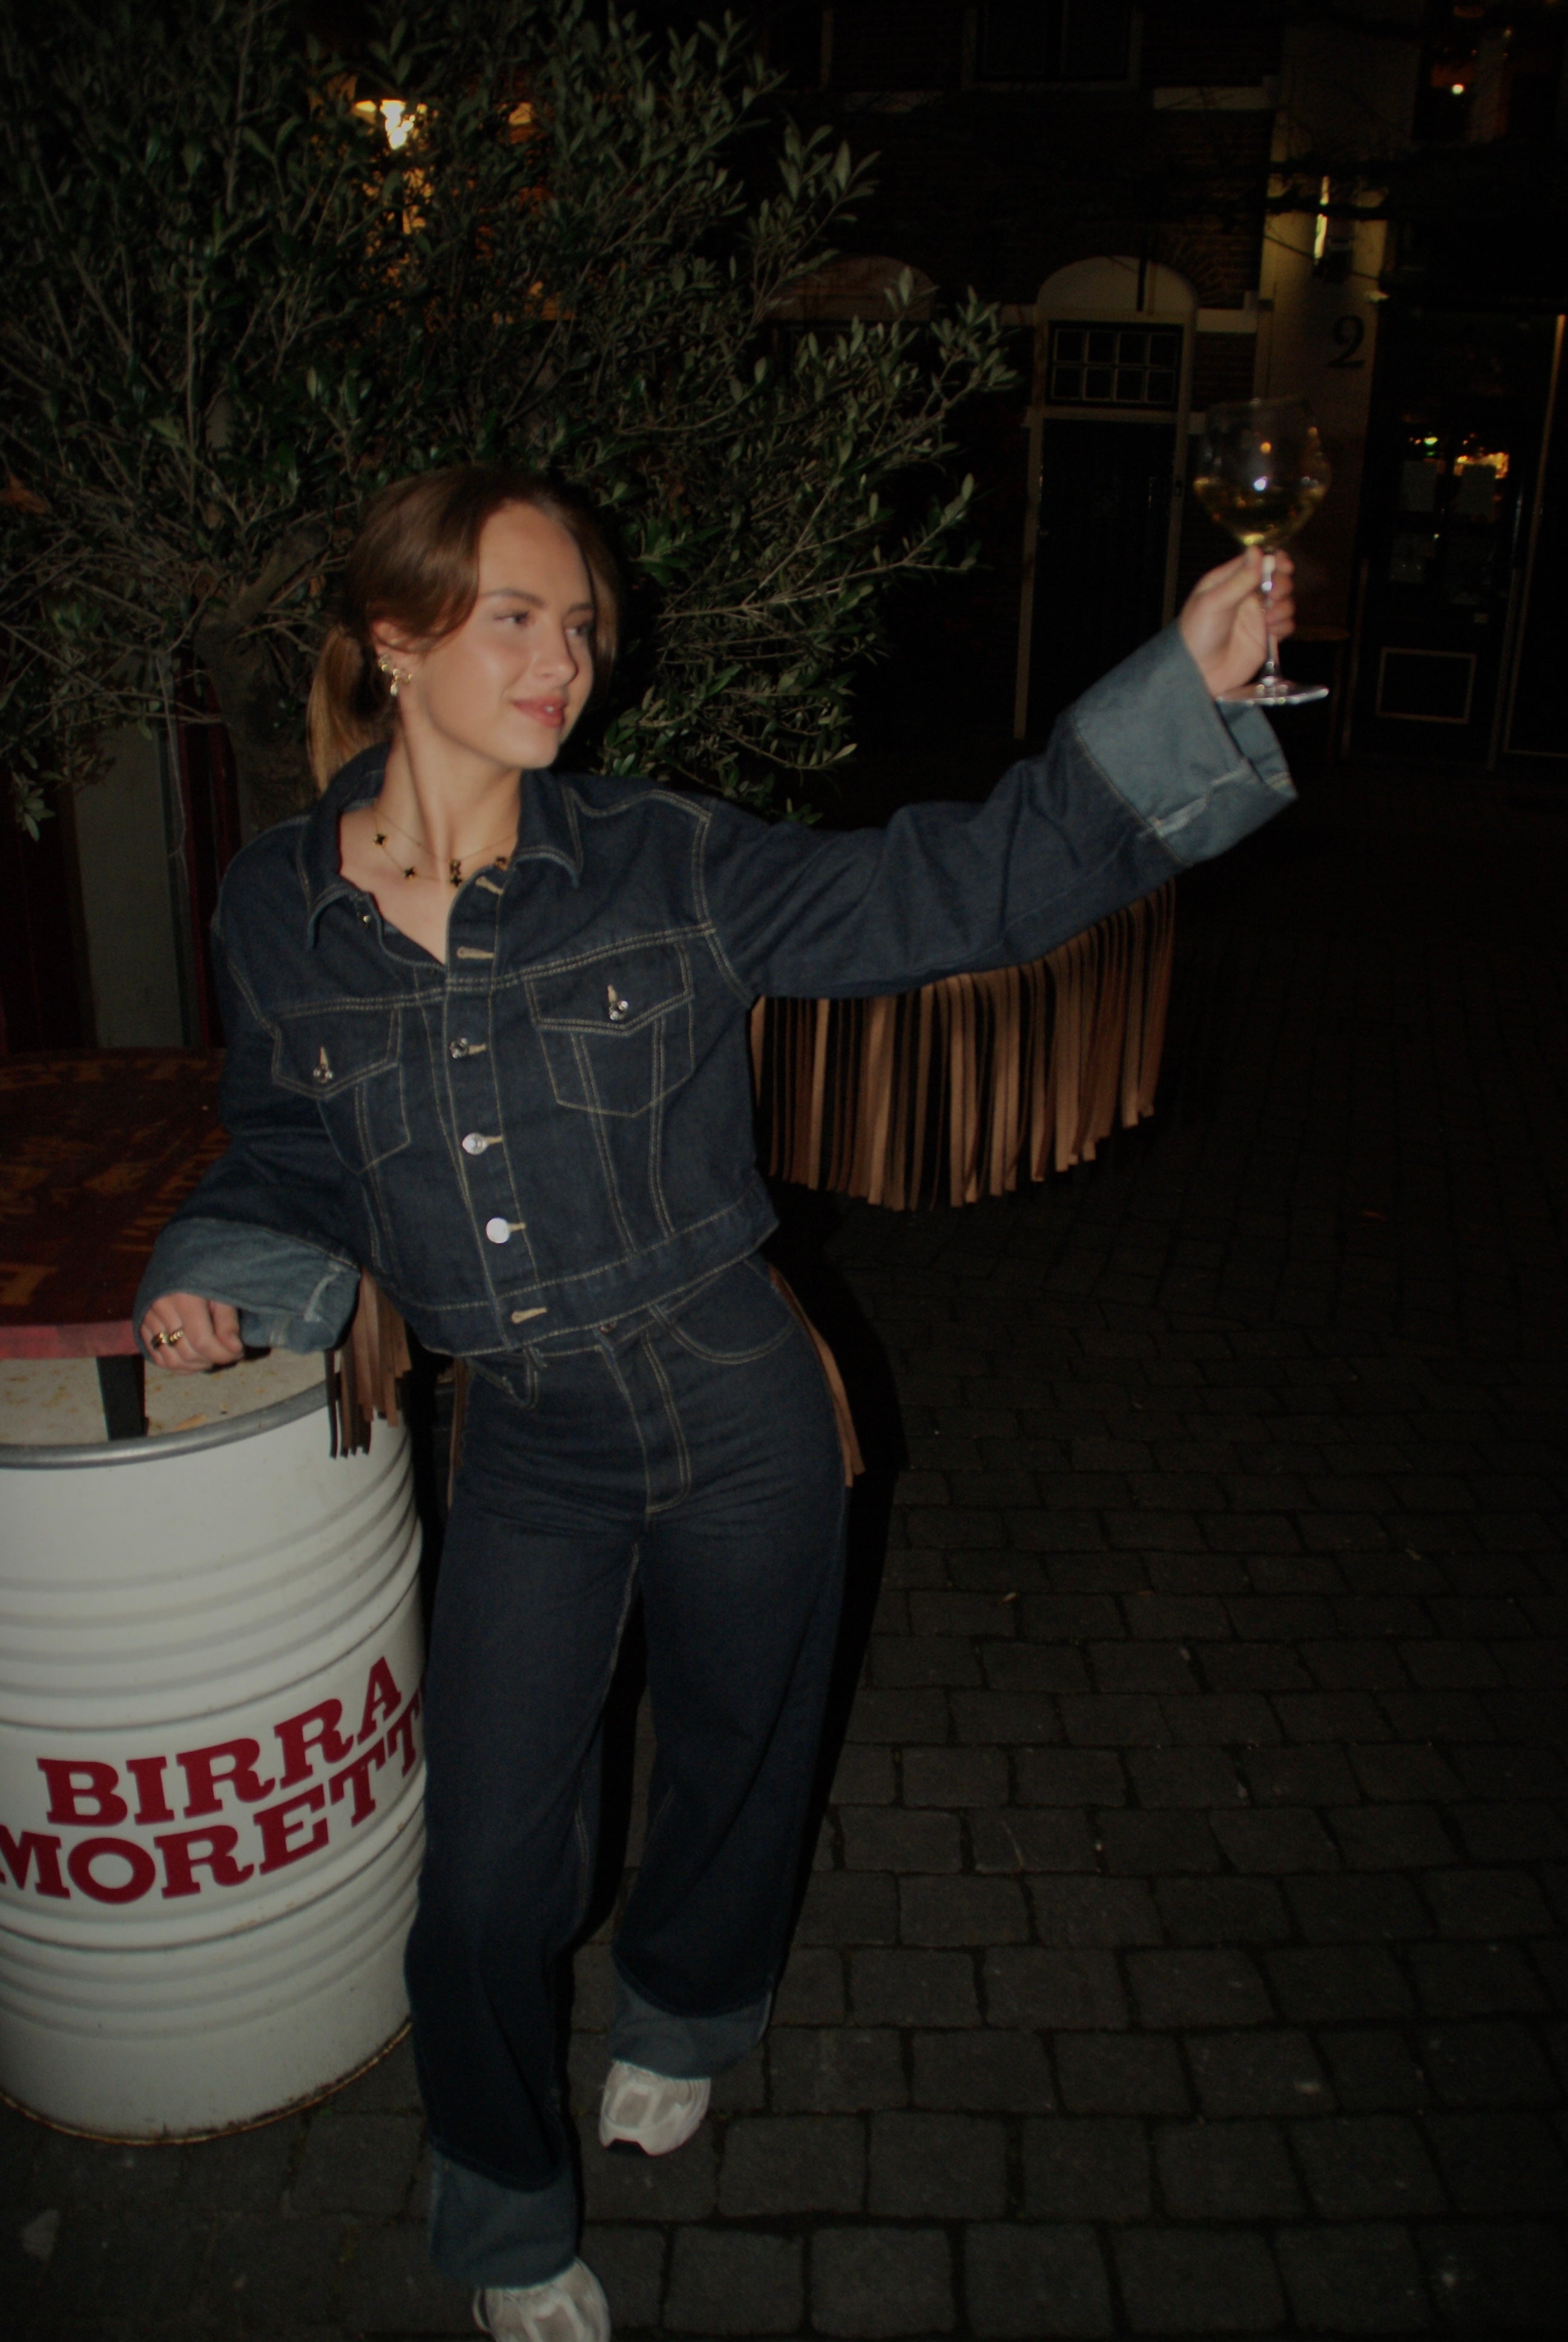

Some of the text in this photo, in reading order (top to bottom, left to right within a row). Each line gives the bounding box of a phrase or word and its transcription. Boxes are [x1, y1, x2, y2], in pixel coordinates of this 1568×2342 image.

[1328, 315, 1365, 368] 2
[0, 1675, 426, 1904] MORETT
[37, 1657, 401, 1826] BIRRA
